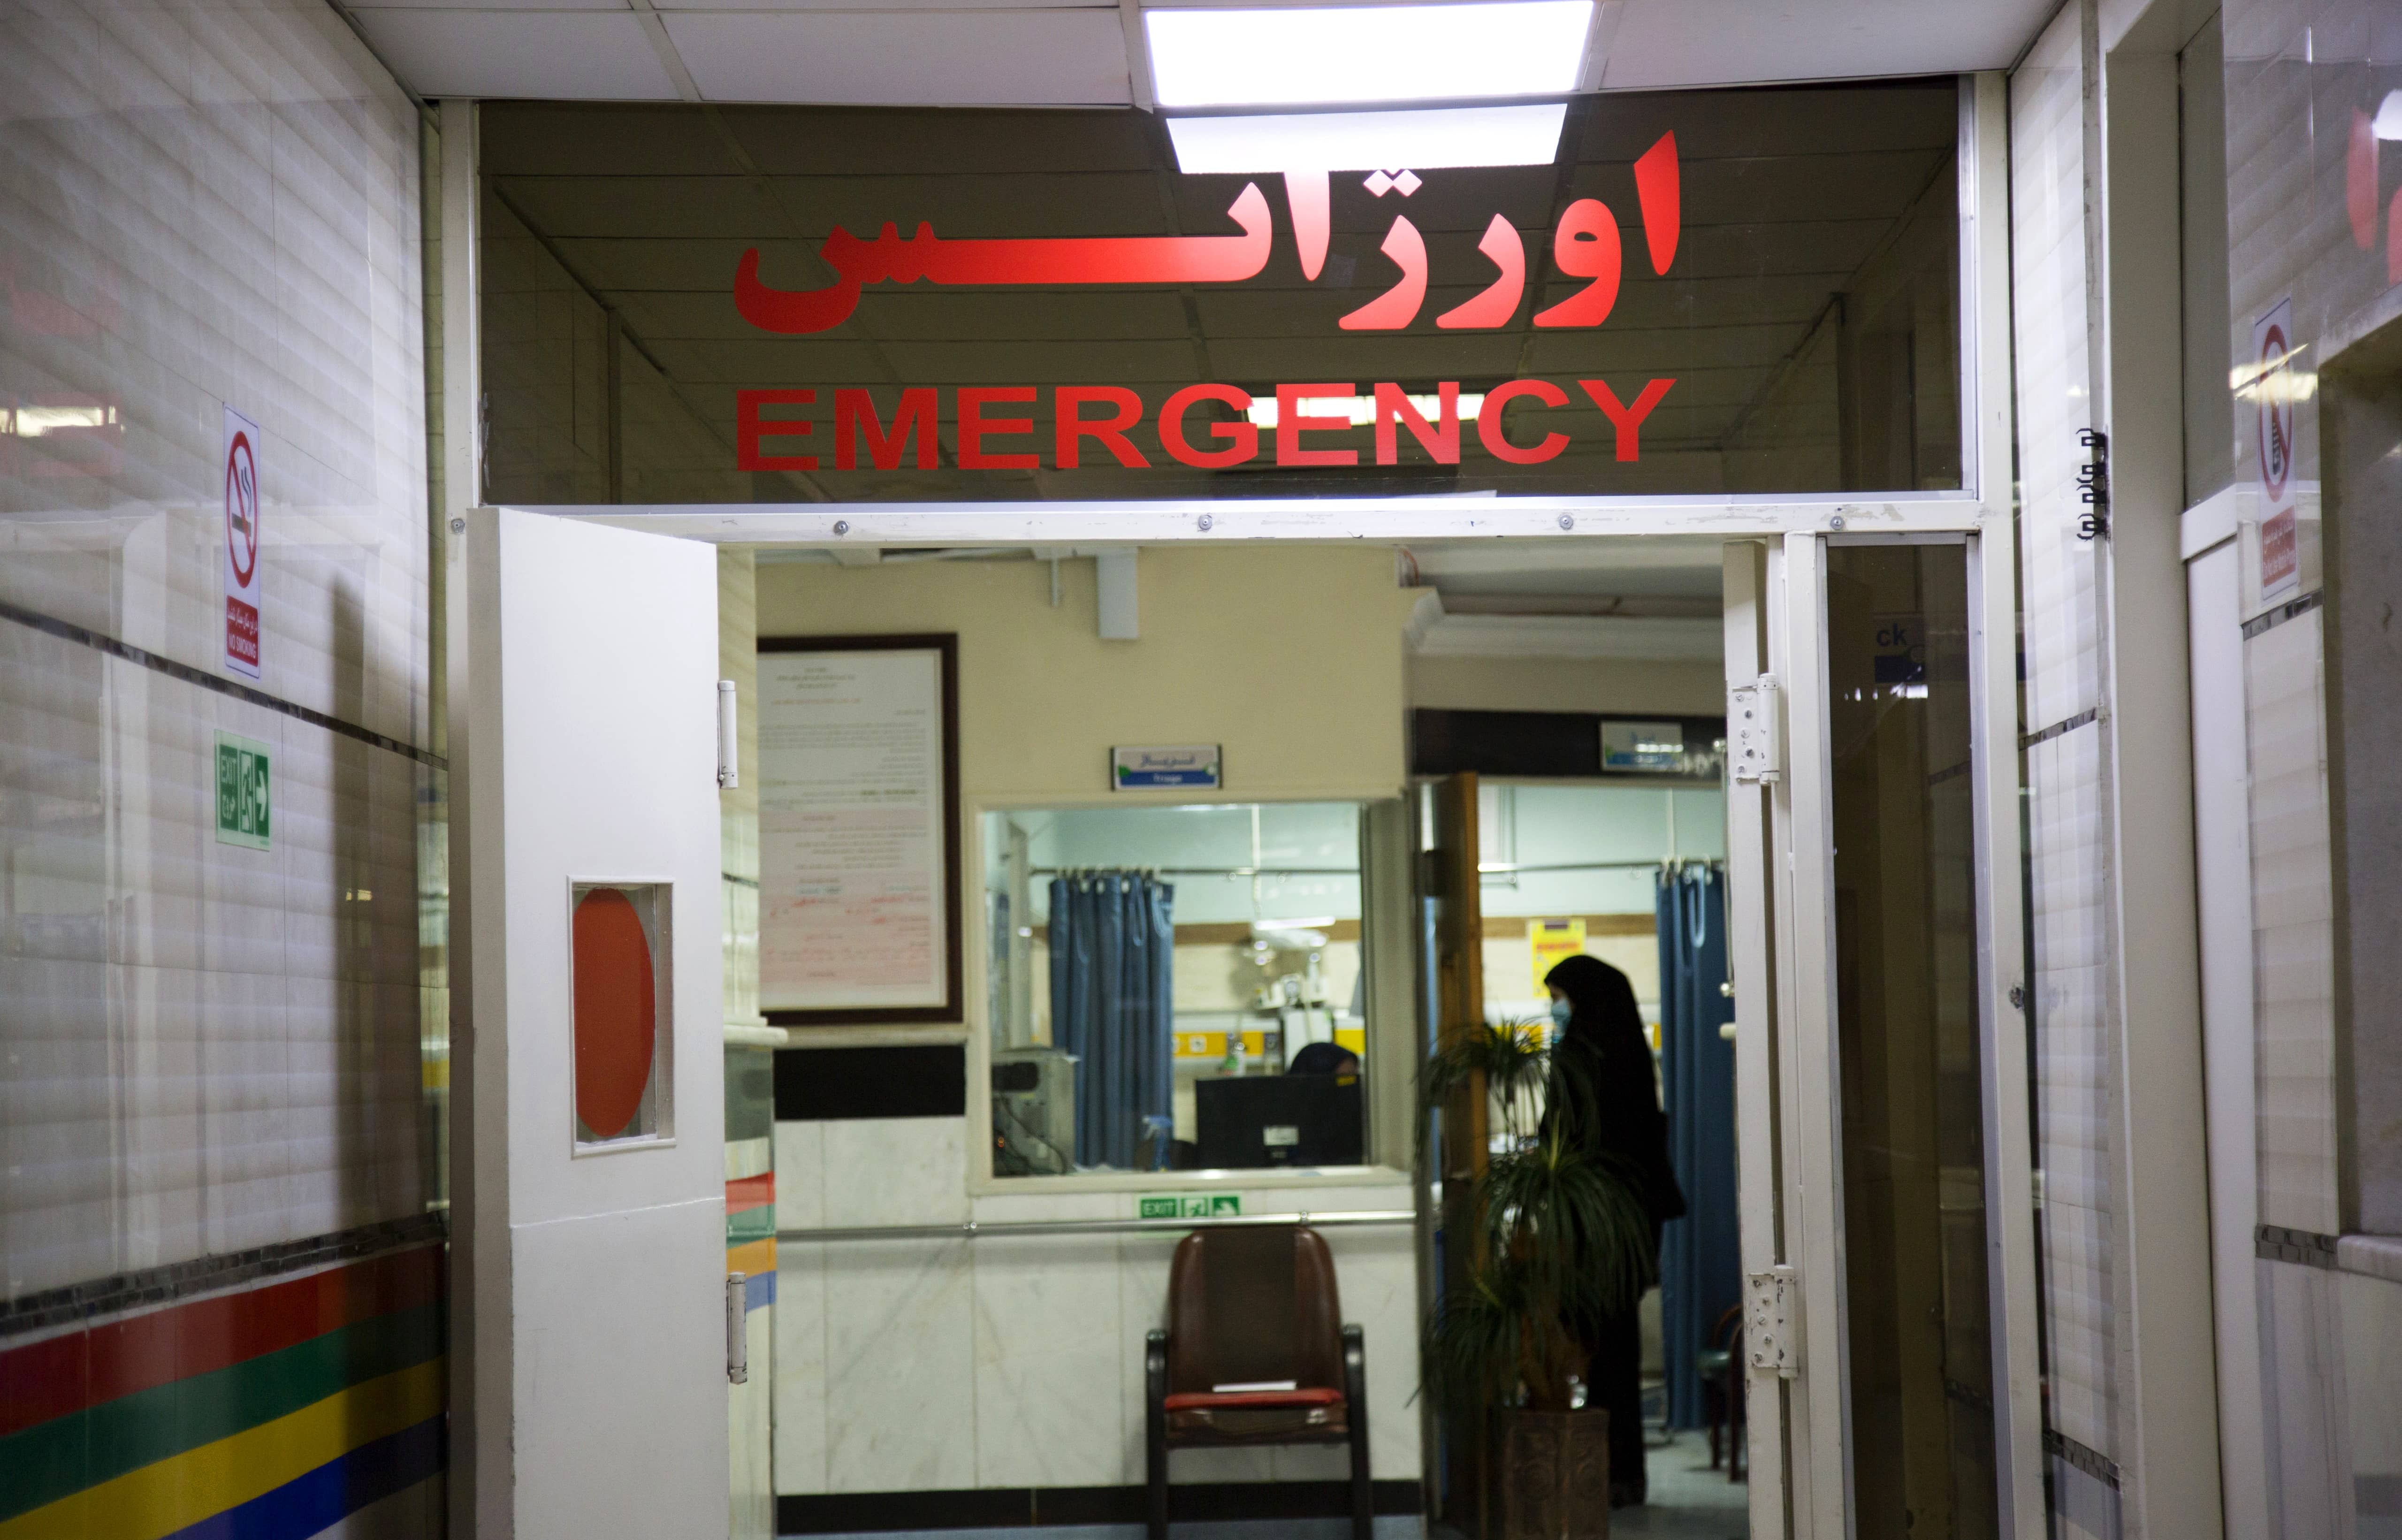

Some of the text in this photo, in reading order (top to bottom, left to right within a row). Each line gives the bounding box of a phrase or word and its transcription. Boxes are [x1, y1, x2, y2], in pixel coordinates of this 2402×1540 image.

[736, 378, 1677, 471] EMERGENCY
[229, 633, 256, 659] NO SMOKING
[221, 754, 236, 785] EXIT
[1144, 1201, 1174, 1216] EXIT
